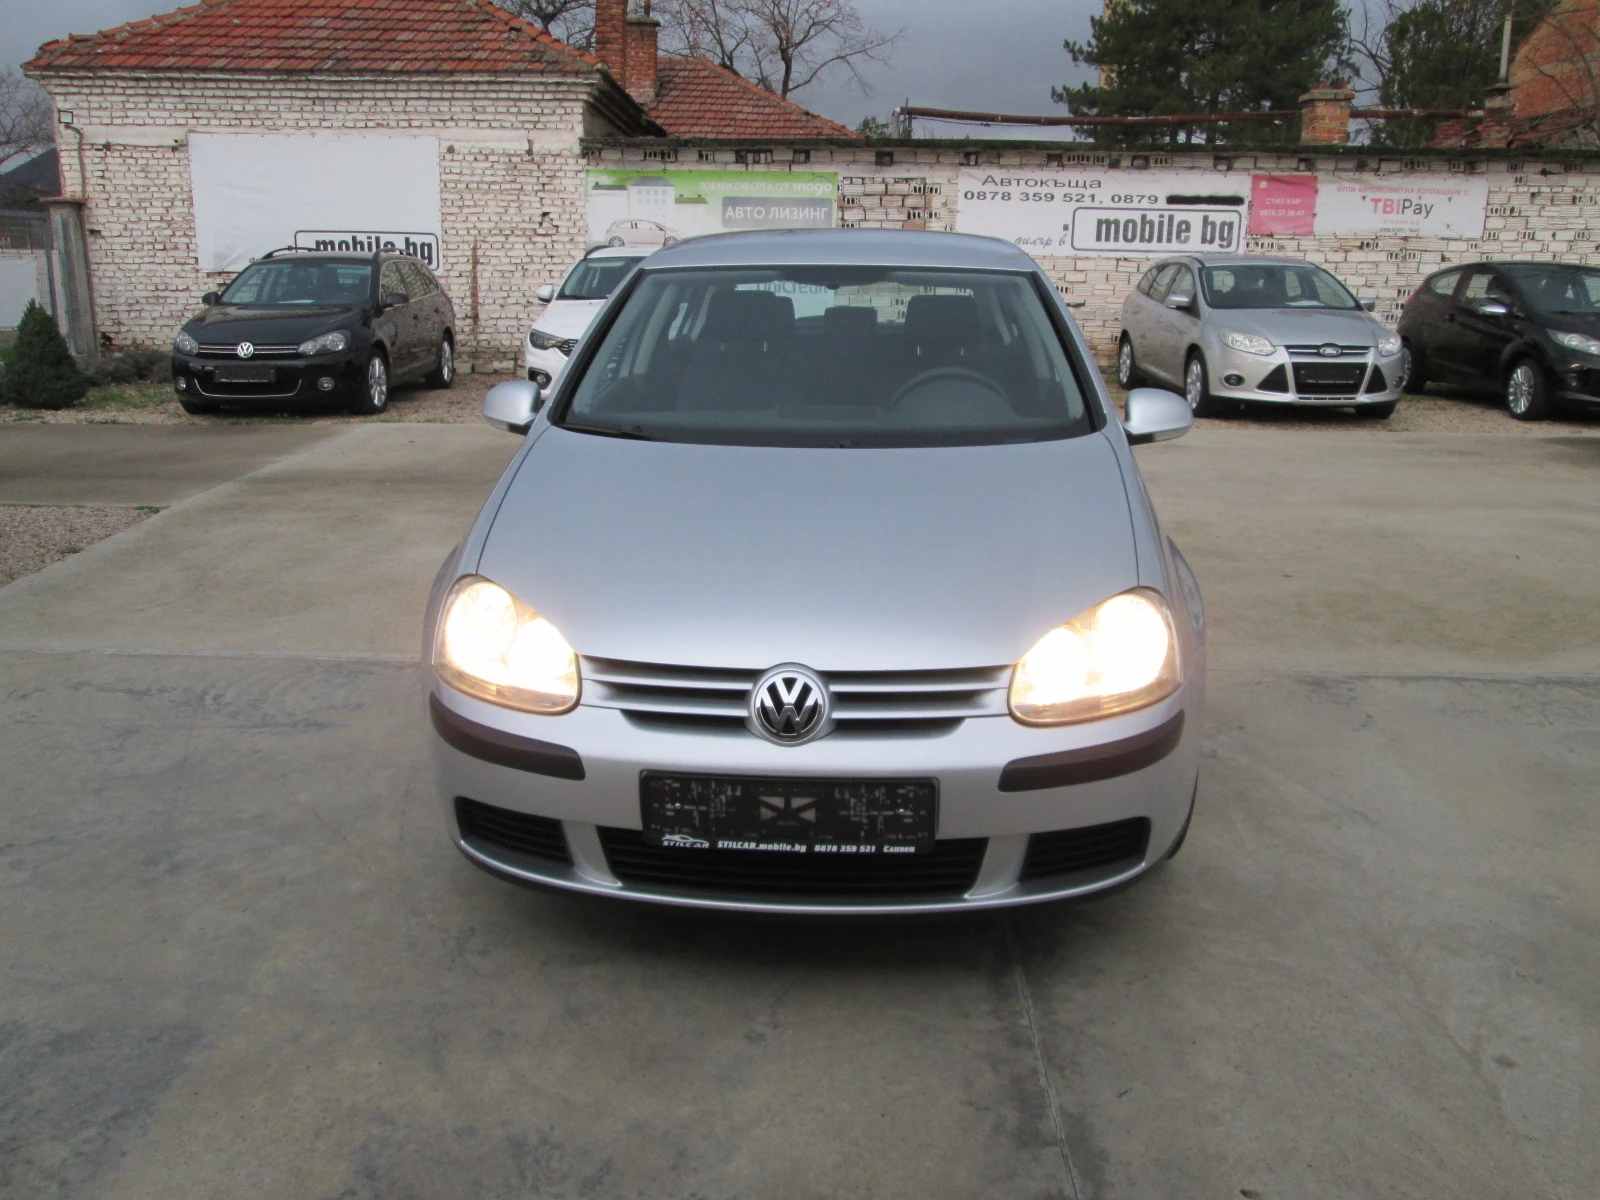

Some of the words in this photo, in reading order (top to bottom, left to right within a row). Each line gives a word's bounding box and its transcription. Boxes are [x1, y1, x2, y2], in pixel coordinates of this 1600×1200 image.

[792, 182, 833, 196] mogo
[981, 174, 1102, 190] Автокъща
[963, 191, 1012, 202] 0878
[1019, 192, 1055, 202] 359
[1062, 193, 1103, 205] 521,
[1110, 193, 1159, 205] 0879
[725, 206, 766, 219] АВТО
[768, 206, 829, 219] ЛИЗИНГ
[1370, 197, 1434, 219] TBIPay
[1095, 213, 1192, 245] mobile
[1200, 214, 1235, 250] bg
[662, 840, 710, 849] STILCAR
[717, 840, 807, 853] STILCAR.mobile.bg
[814, 844, 838, 853] 0878
[840, 844, 857, 853] 359
[859, 844, 876, 853] 521
